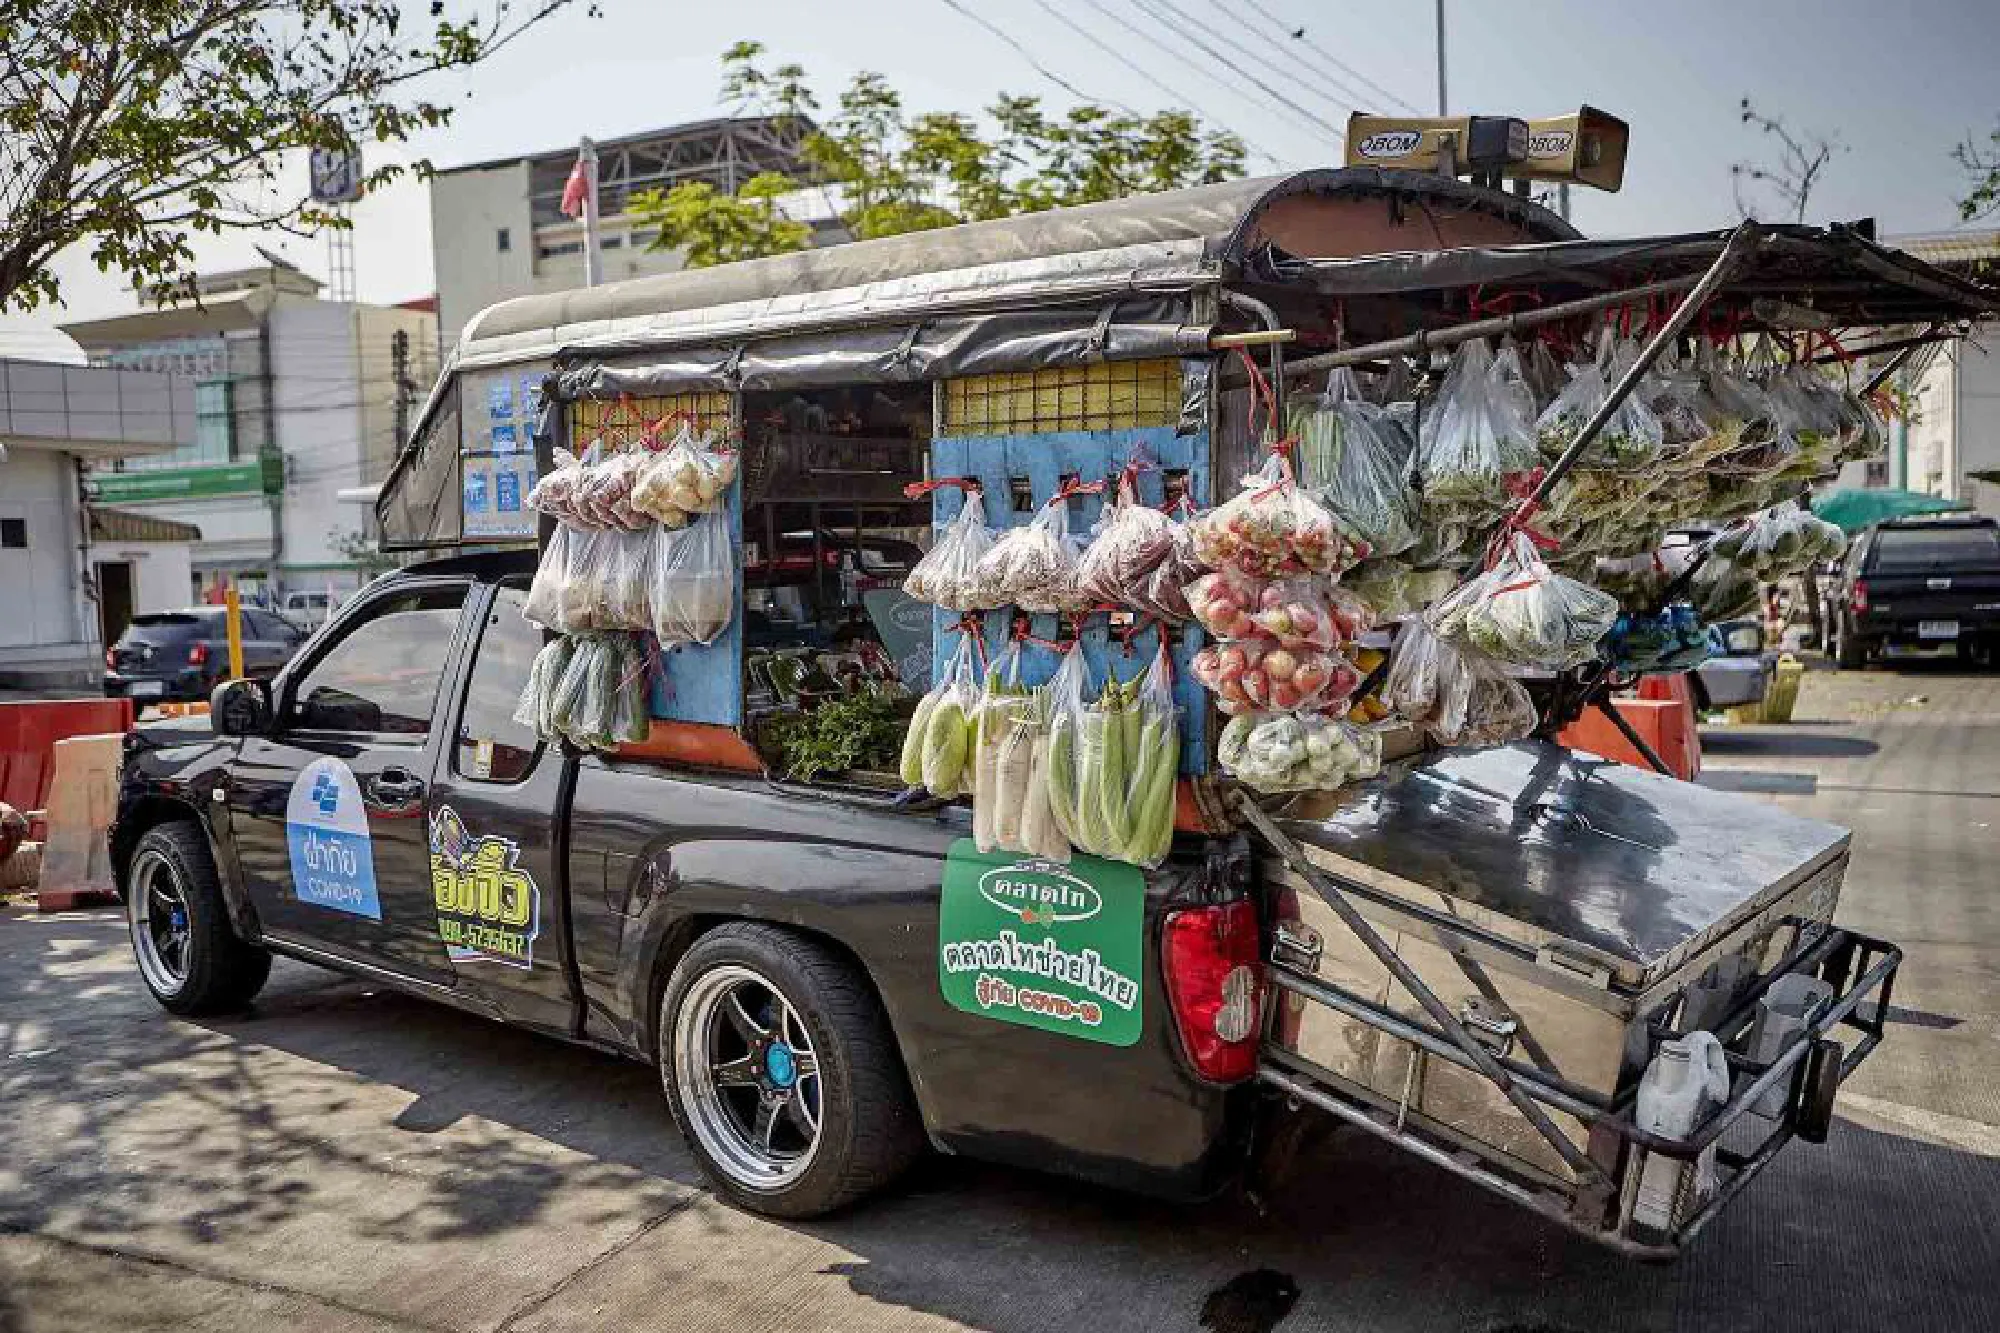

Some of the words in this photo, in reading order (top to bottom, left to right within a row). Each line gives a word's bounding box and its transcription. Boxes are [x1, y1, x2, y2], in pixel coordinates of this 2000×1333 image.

[995, 879, 1085, 908] ตลาดไท
[943, 931, 1138, 1010] ตลาดไทช่วยไทย
[1019, 990, 1102, 1025] COVID-19
